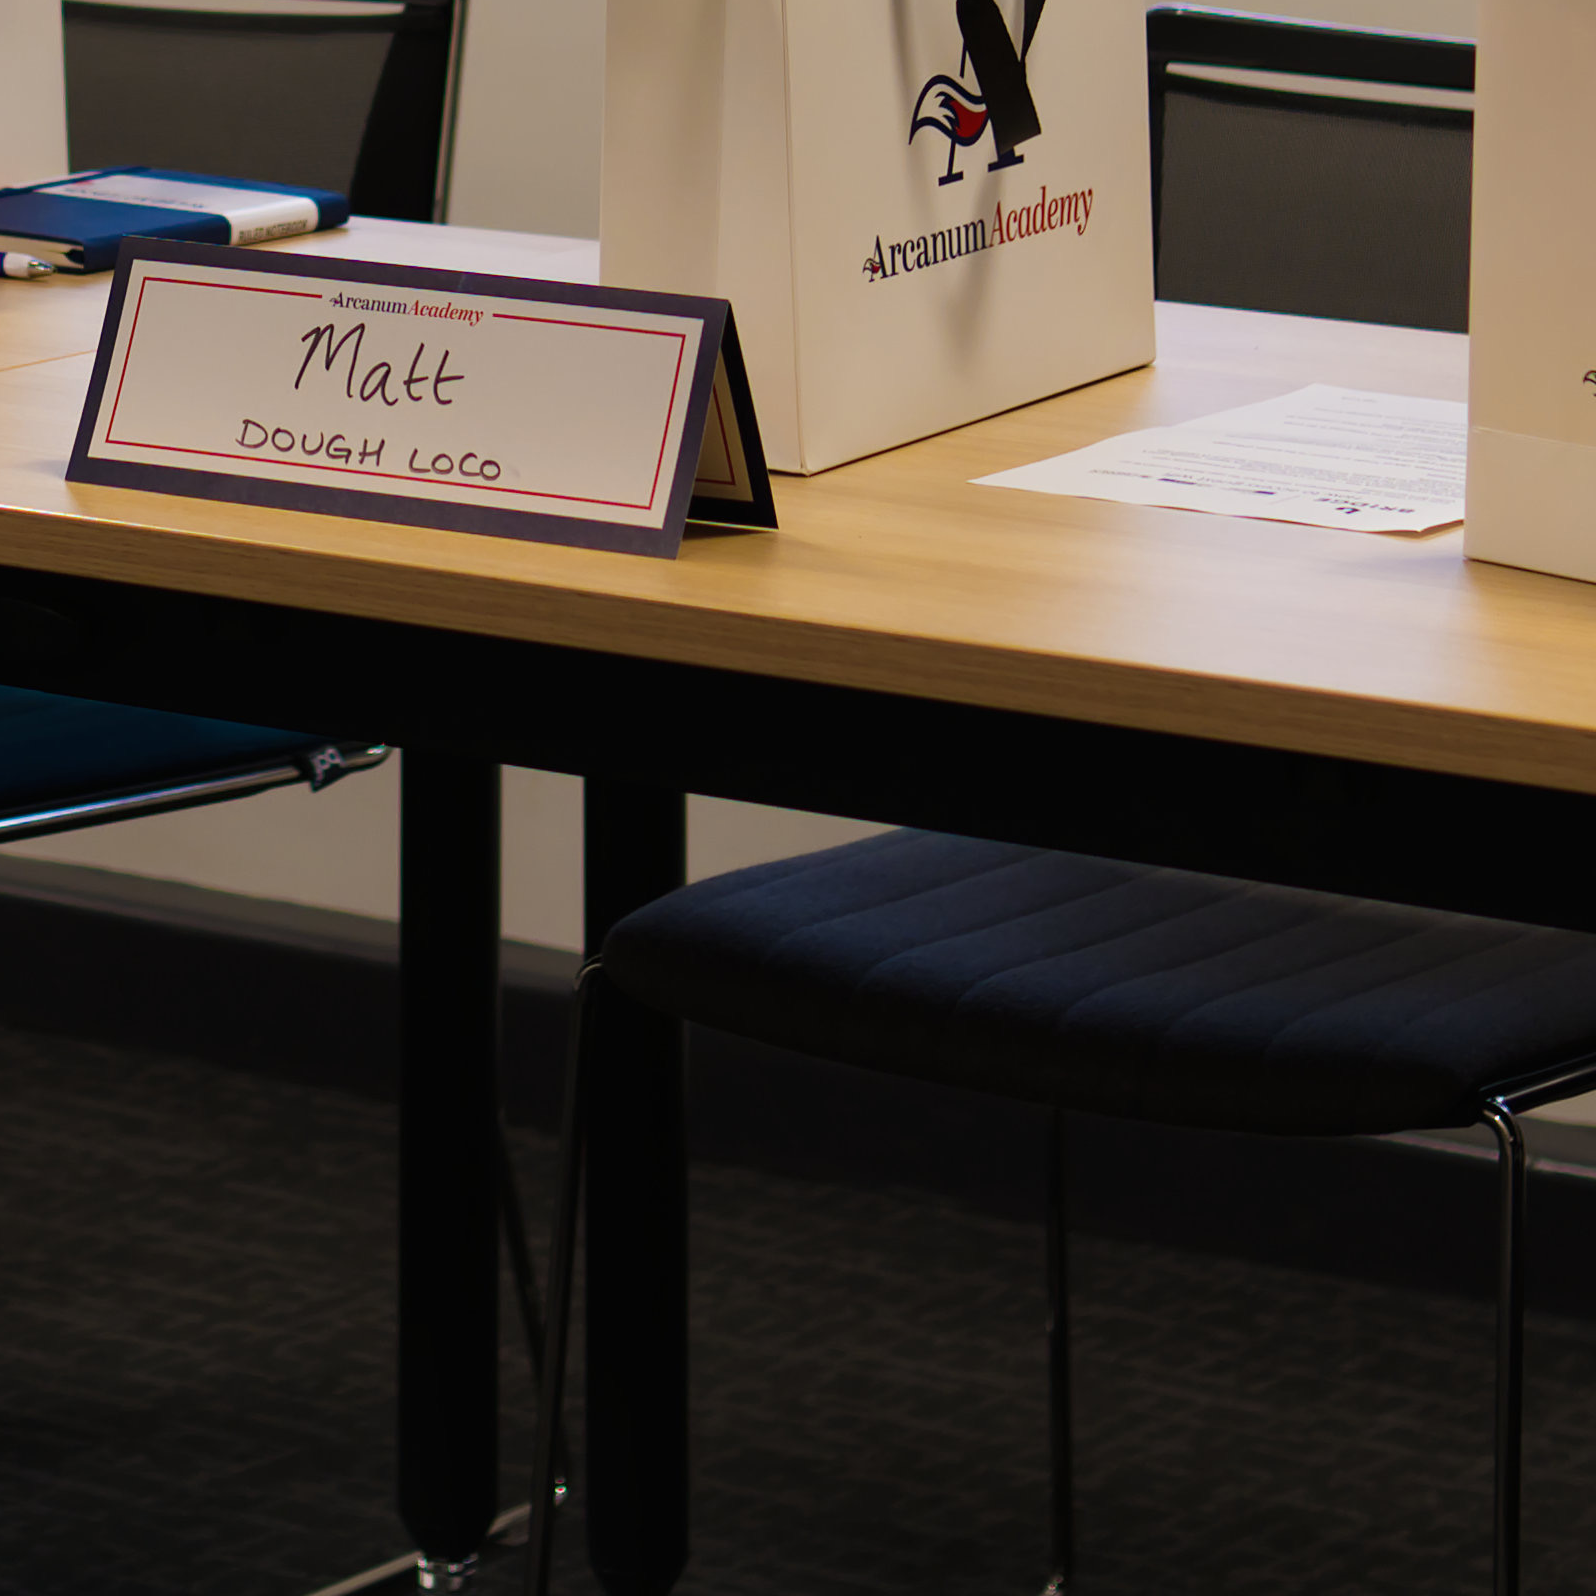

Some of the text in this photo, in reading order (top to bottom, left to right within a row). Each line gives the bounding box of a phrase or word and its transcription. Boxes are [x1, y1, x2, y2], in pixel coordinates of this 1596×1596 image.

[862, 186, 1094, 283] Arcanum Academy
[330, 290, 484, 327] Arcanum Academy
[293, 322, 465, 407] Matt
[235, 418, 502, 482] DOUGH LOCO
